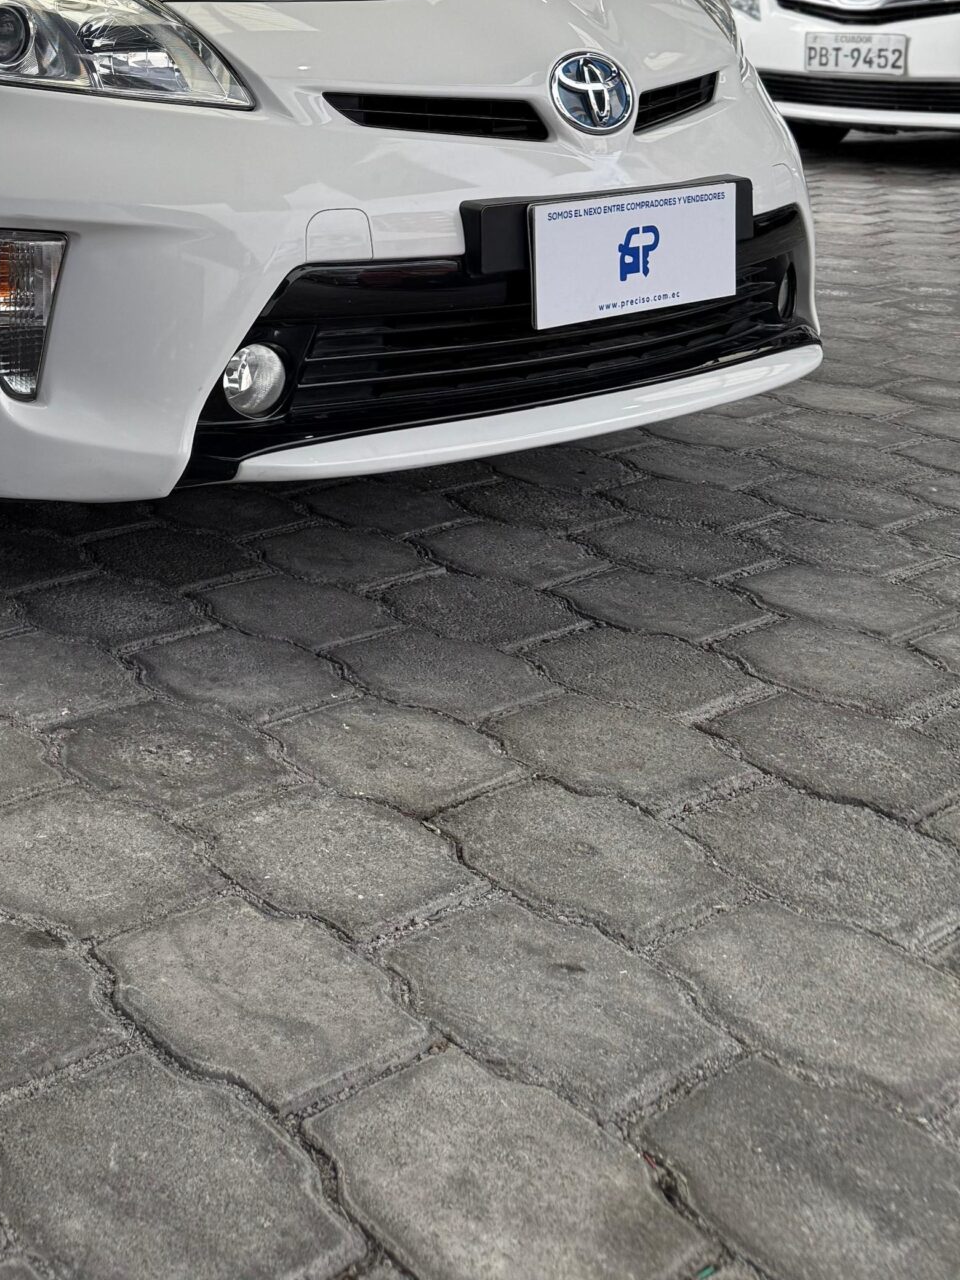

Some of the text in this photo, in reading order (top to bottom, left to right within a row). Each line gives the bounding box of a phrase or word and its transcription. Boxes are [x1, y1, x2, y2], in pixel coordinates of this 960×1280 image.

[835, 34, 873, 43] ECUADOR
[807, 46, 903, 69] PBT-9452
[547, 191, 725, 221] SOMOS EL NEXO ENTRE COMPRADORES Y VENDEDORES
[598, 291, 680, 311] www.preciso.com.ec
